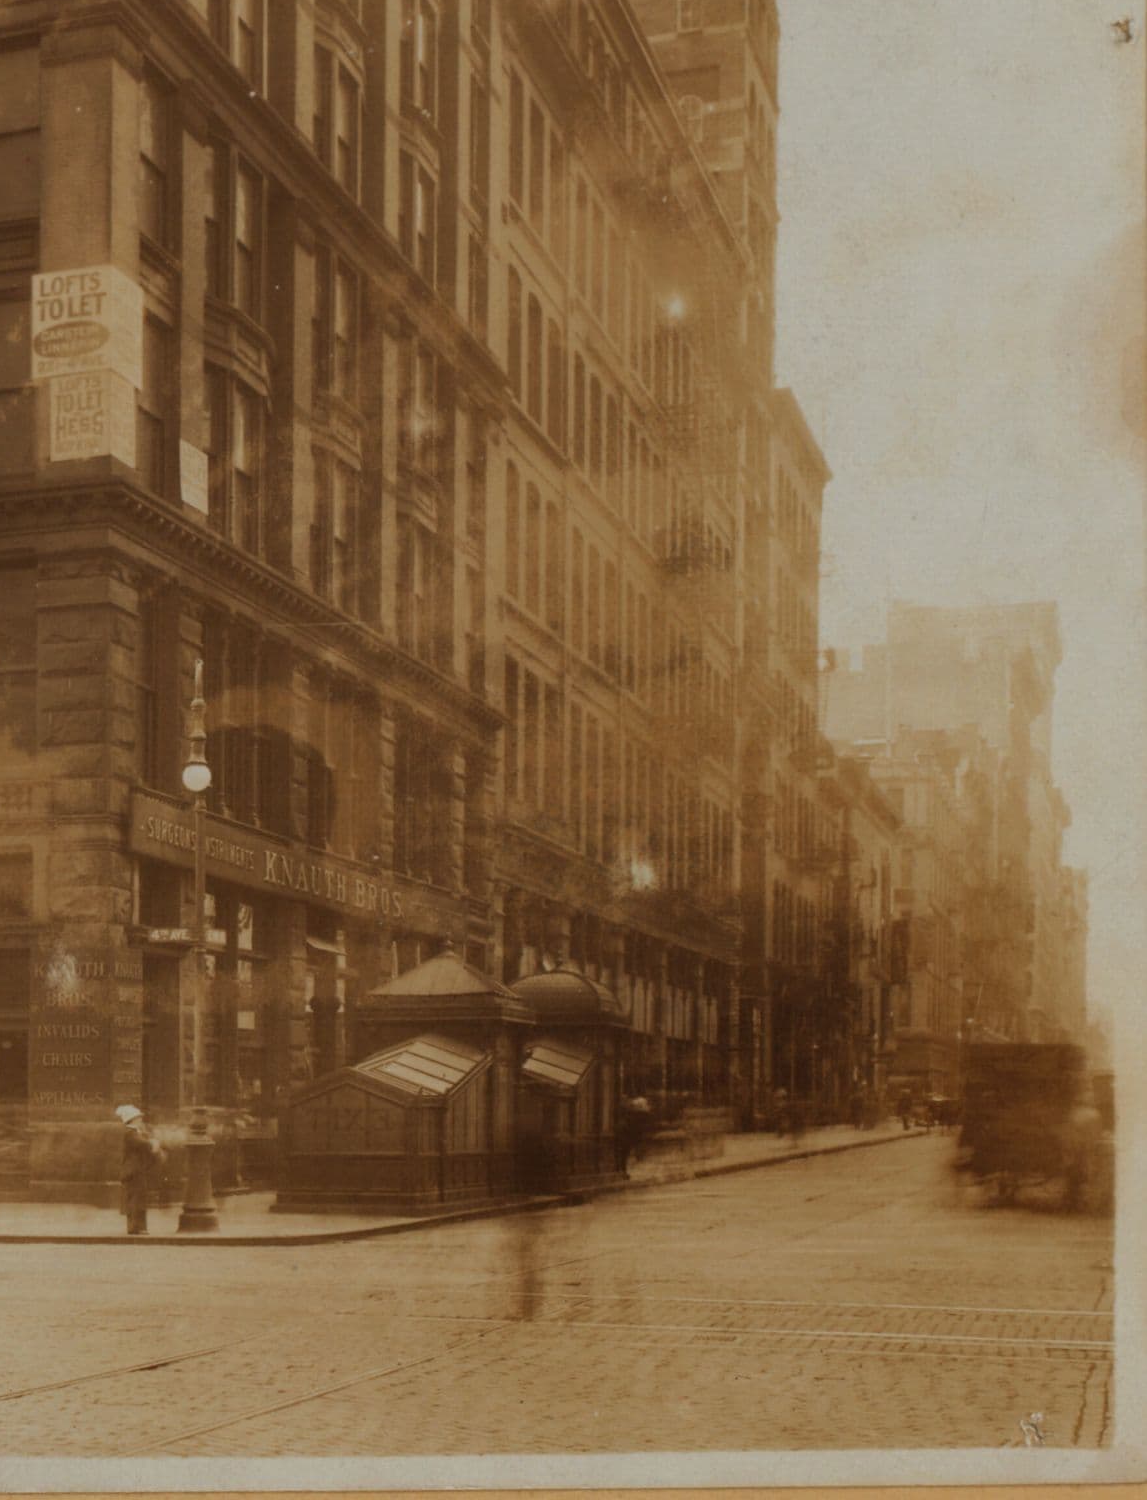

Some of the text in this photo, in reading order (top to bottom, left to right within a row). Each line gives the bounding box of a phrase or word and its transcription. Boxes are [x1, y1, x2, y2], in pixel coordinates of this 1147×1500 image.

[39, 271, 101, 298] LOFTS
[36, 292, 107, 322] TO LET
[55, 388, 103, 413] TO LET
[55, 409, 103, 441] HESS
[147, 815, 197, 852] SURGEONS
[204, 835, 255, 871] NSTRUMENTS
[263, 849, 347, 904] KNAUTH
[37, 1023, 102, 1038] INVALIDS
[41, 1051, 94, 1067] CHAIRS
